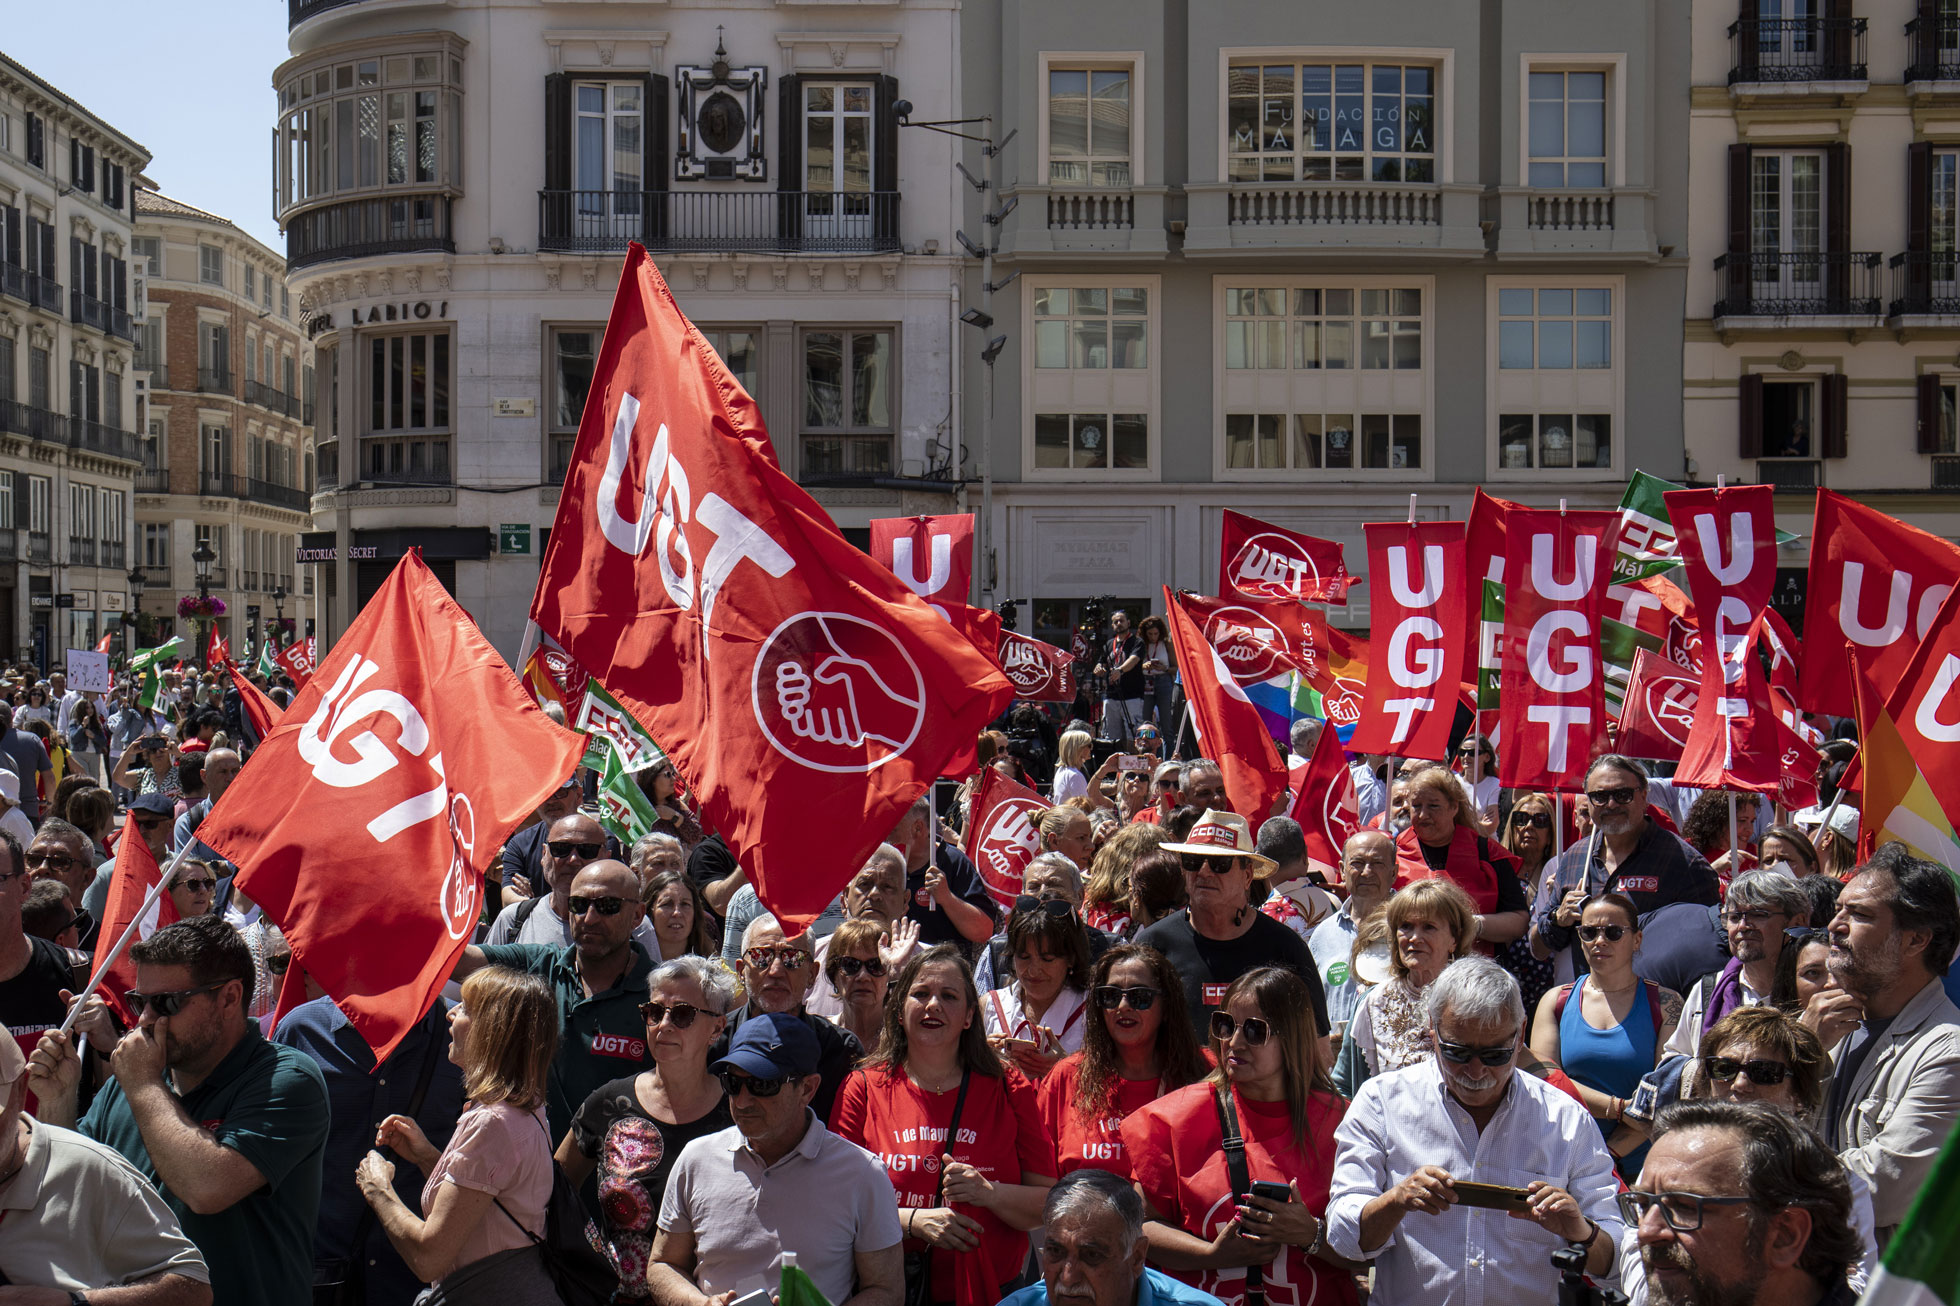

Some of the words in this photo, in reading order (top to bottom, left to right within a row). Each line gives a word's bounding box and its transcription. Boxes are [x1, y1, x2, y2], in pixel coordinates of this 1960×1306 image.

[1235, 122, 1427, 149] MÁLAGA
[351, 301, 448, 325] LARIOS
[597, 391, 797, 662] UGT
[296, 547, 338, 561] VICTORIA'S
[348, 546, 377, 559] SECRET
[1238, 543, 1308, 594] UGT
[1383, 545, 1445, 745] UGT
[1526, 533, 1598, 774] UGT
[286, 647, 315, 677] UGT
[297, 652, 449, 843] UGT
[1191, 825, 1226, 838] CCOO
[1618, 877, 1645, 889] UGT
[592, 1036, 629, 1054] UGT
[893, 1130, 901, 1144] 1
[902, 1128, 917, 1143] de
[1082, 1142, 1125, 1160] UGT
[905, 1191, 925, 1208] los
